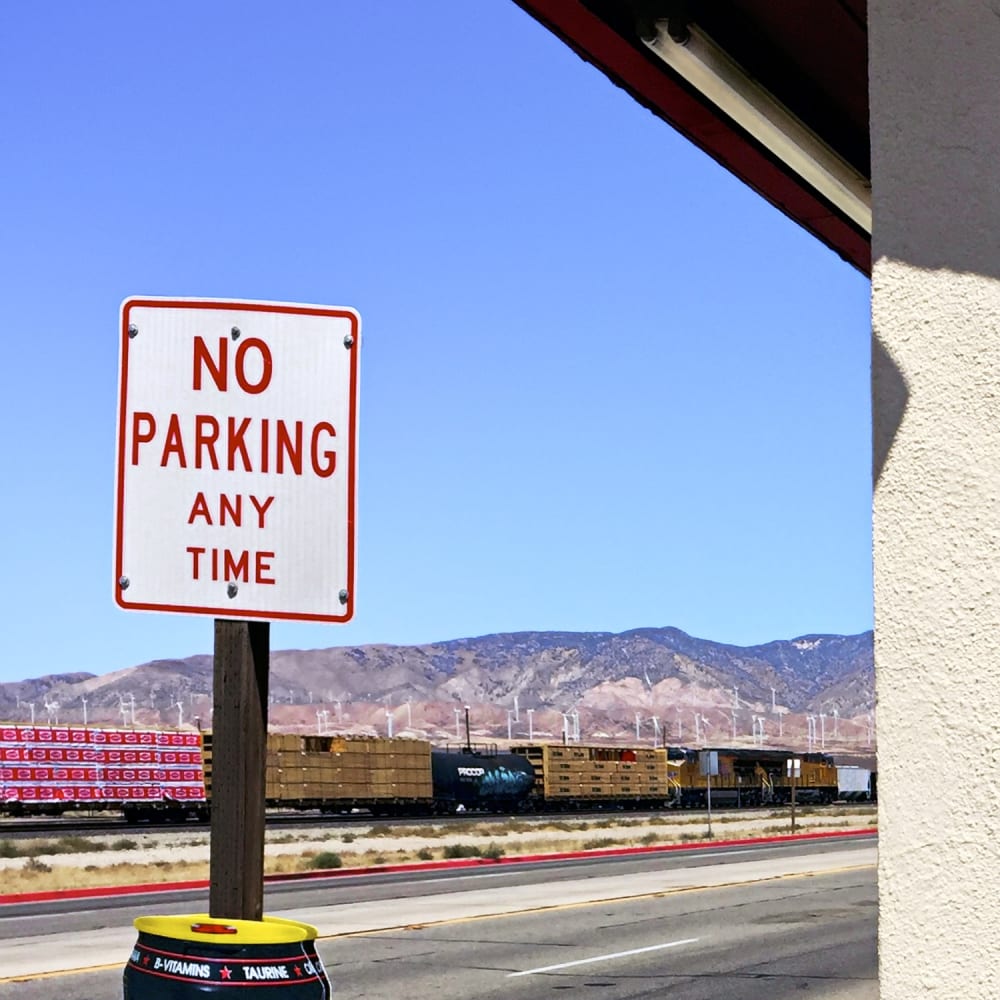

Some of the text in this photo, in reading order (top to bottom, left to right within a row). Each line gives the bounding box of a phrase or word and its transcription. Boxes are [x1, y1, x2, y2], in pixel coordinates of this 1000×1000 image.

[193, 335, 273, 395] NO
[131, 411, 337, 478] PARKING
[188, 492, 275, 528] ANY
[186, 546, 276, 585] TIME
[154, 957, 211, 979] B-VITAMINS
[242, 965, 290, 980] TAURINE
